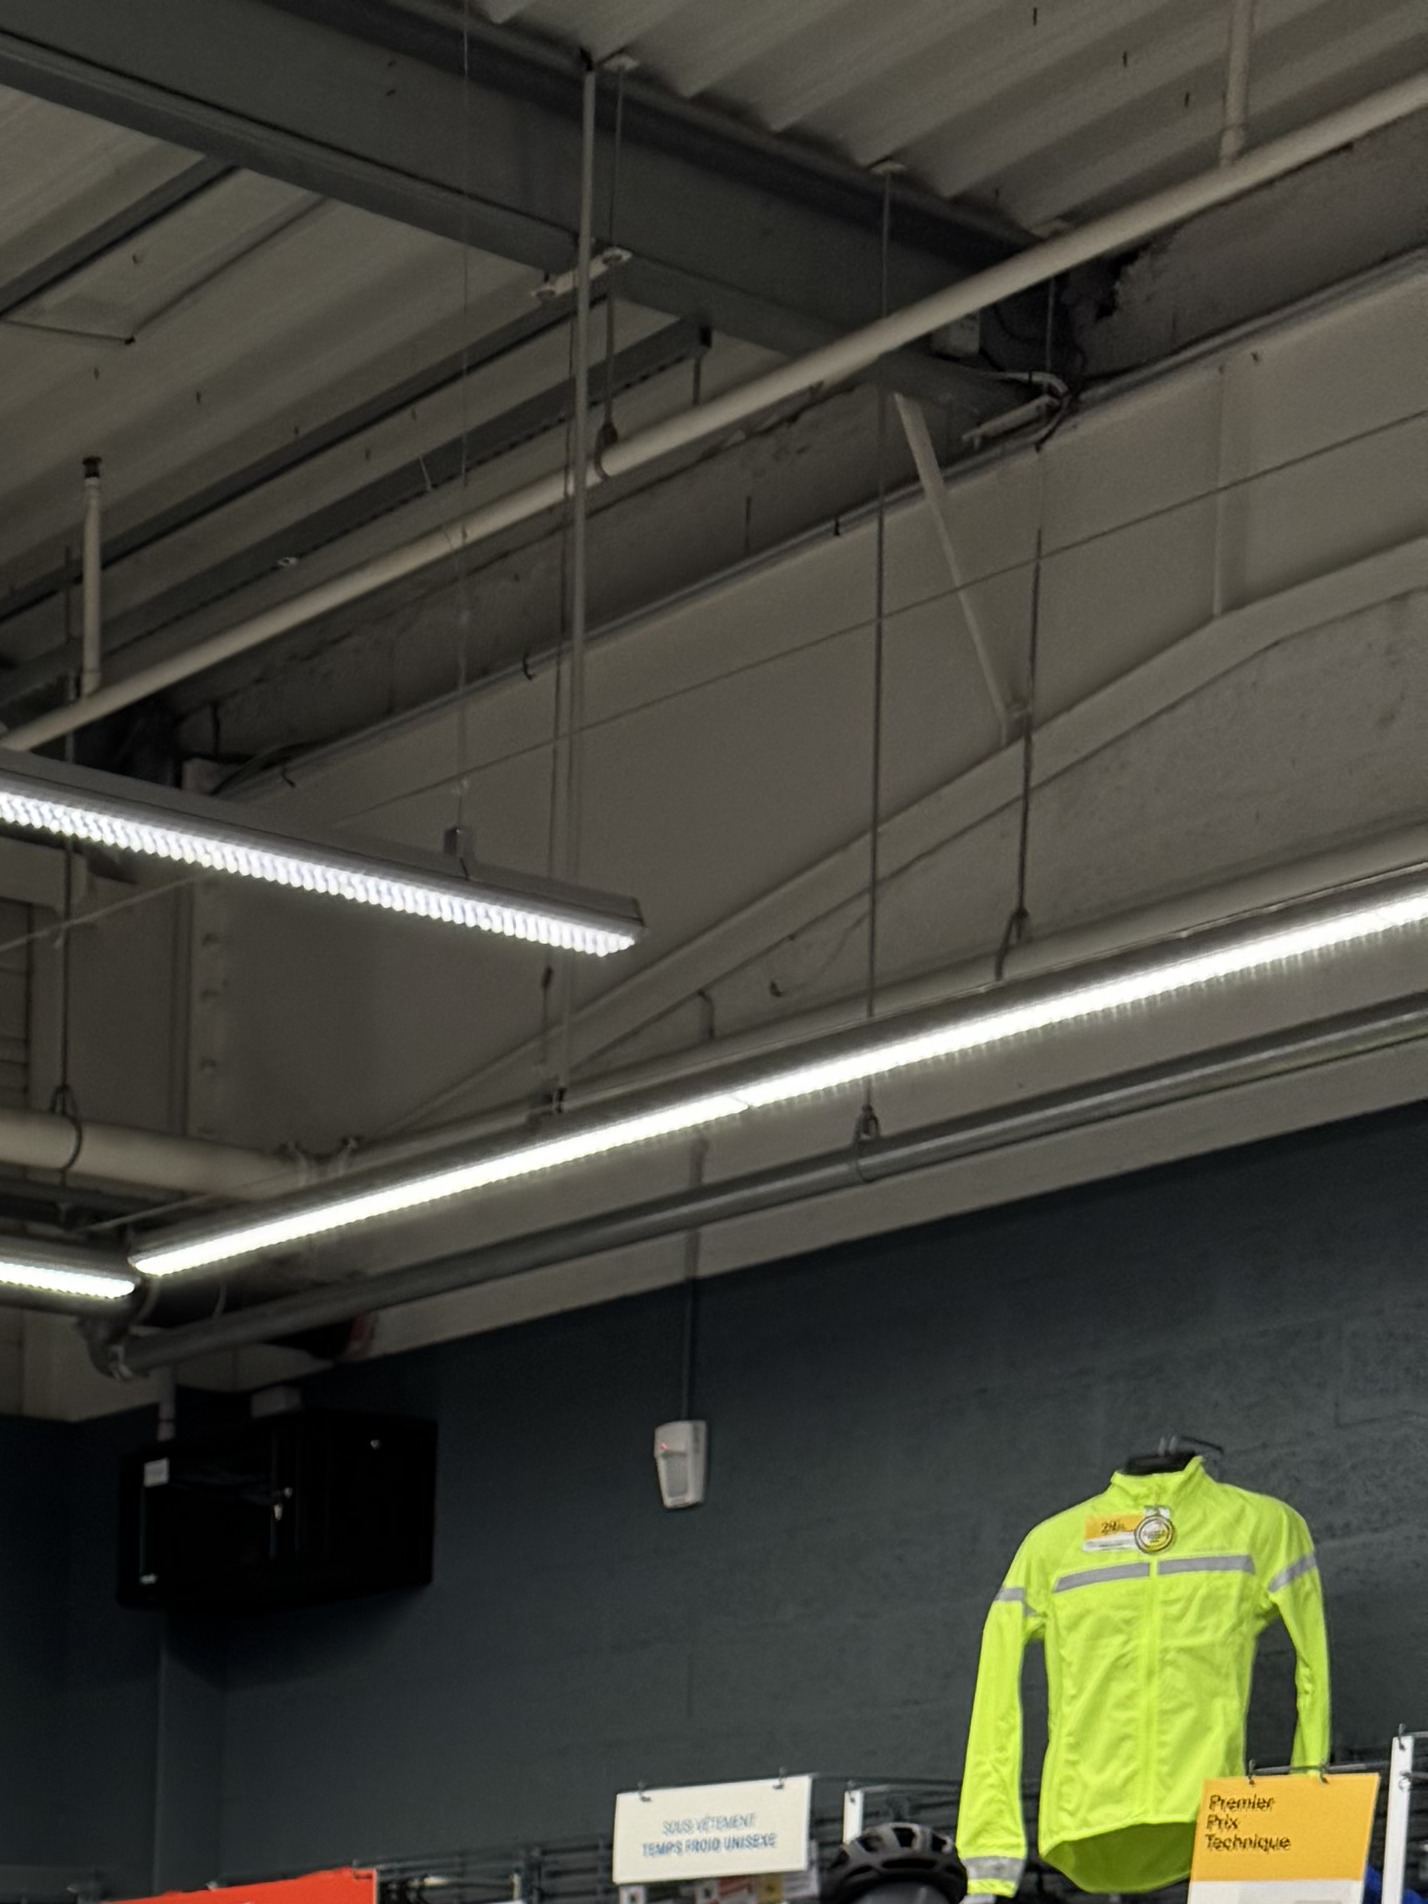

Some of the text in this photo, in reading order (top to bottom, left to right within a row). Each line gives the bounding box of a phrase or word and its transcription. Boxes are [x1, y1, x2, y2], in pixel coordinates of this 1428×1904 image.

[1209, 1794, 1275, 1812] Premier
[662, 1819, 693, 1835] SOUS
[1207, 1814, 1238, 1831] Prix
[642, 1833, 776, 1857] TEMPS FROID UNISEXE
[1205, 1834, 1291, 1854] Technique
